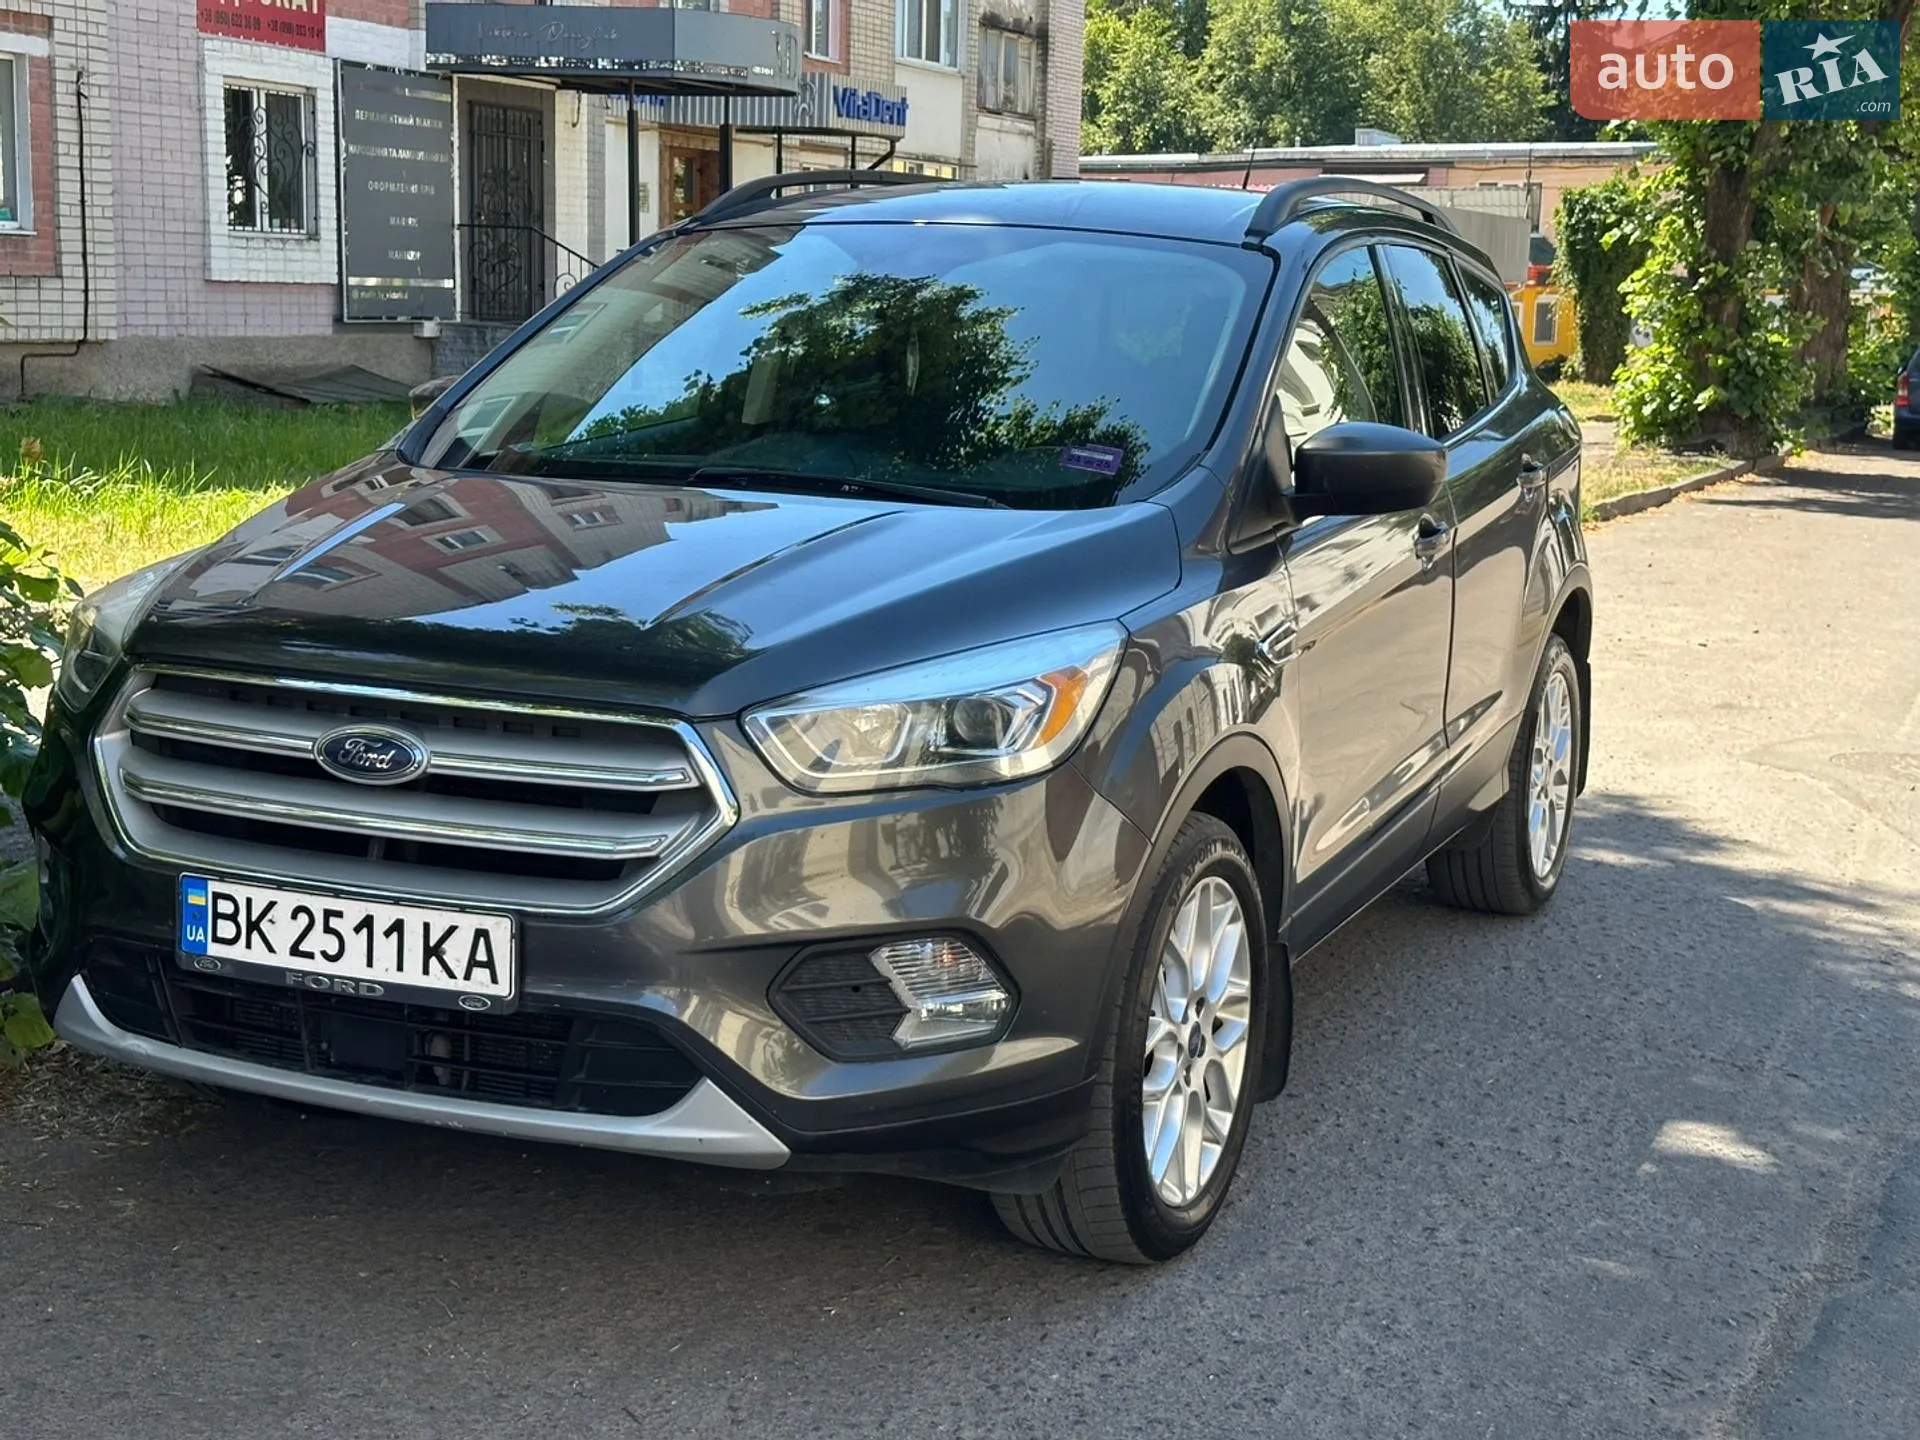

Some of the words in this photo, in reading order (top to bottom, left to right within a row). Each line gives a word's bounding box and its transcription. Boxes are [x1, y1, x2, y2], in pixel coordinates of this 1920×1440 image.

[832, 84, 909, 127] VitaDent
[337, 738, 396, 769] Ford
[186, 924, 206, 943] UA
[211, 890, 279, 955] BK
[288, 904, 405, 972] 2511
[422, 920, 499, 985] KA
[285, 971, 385, 997] FORD
